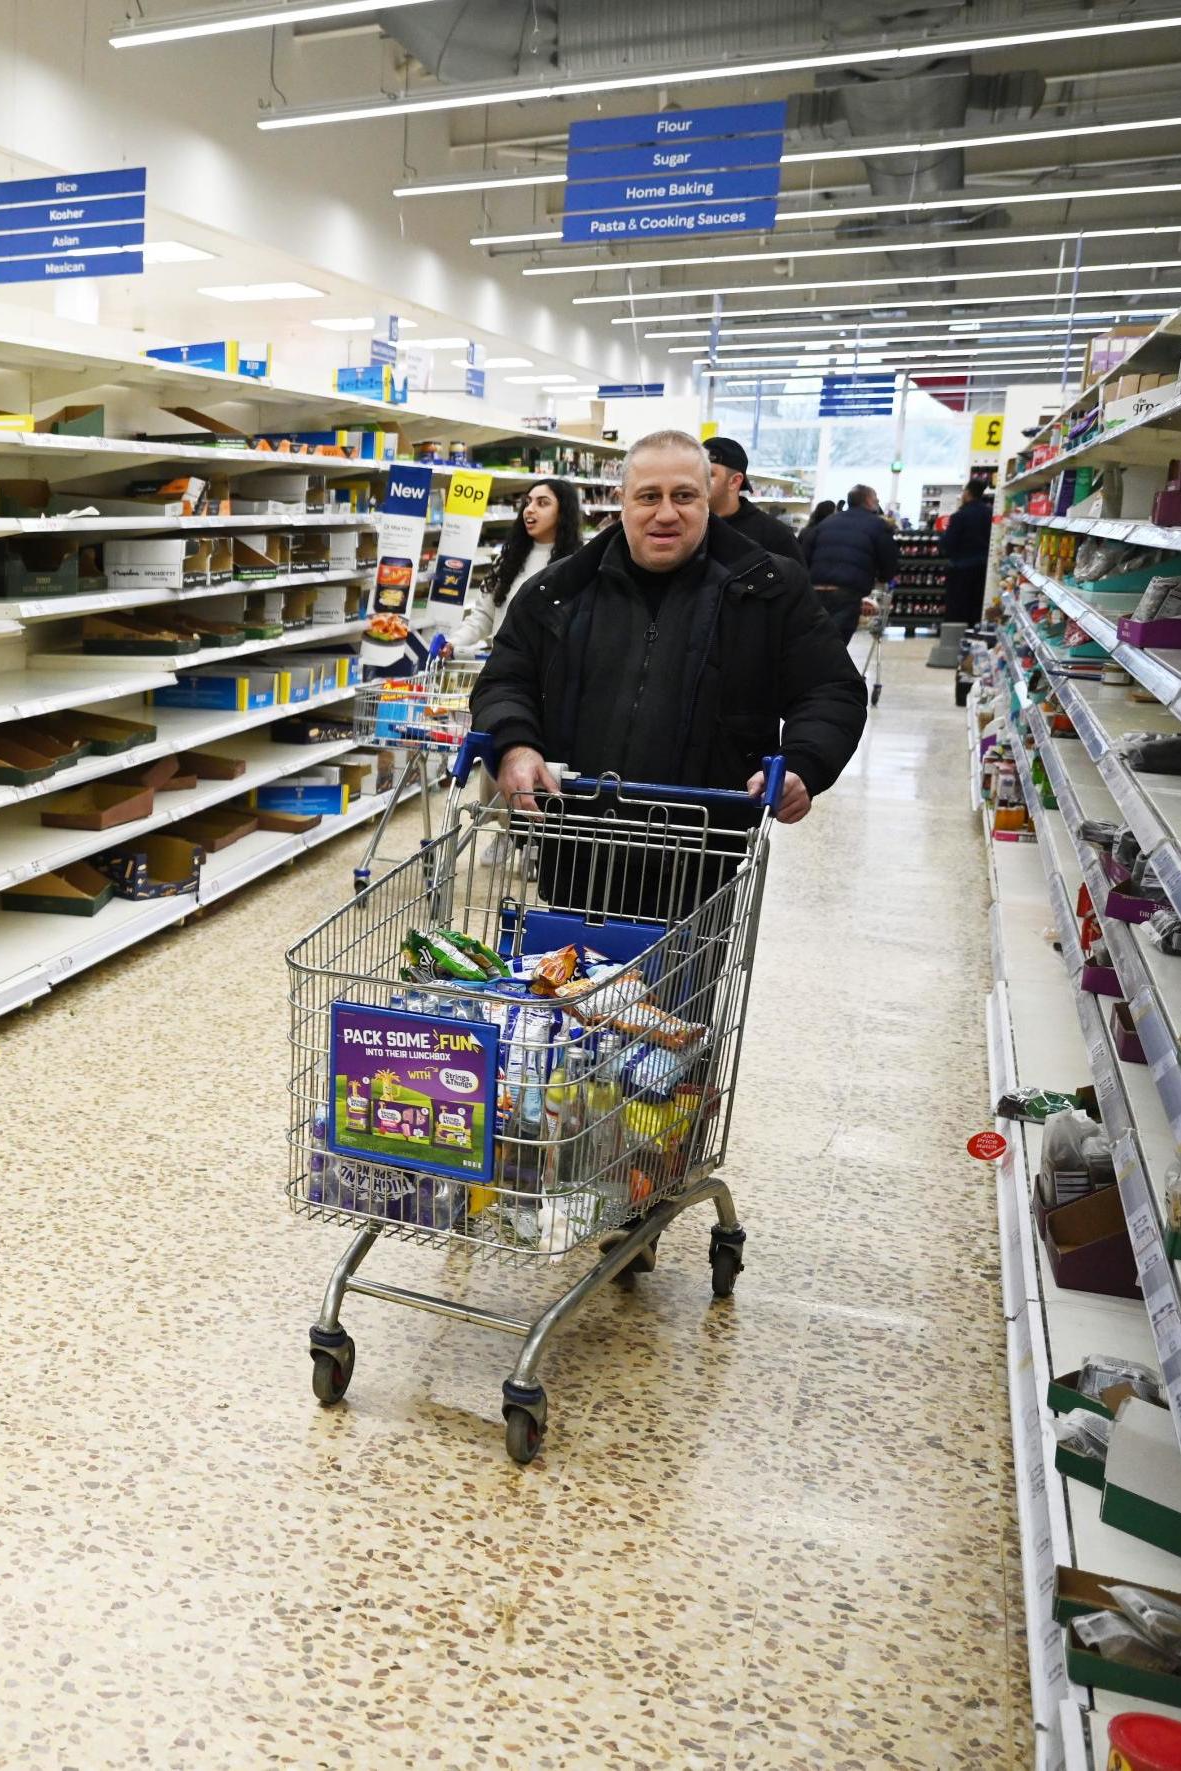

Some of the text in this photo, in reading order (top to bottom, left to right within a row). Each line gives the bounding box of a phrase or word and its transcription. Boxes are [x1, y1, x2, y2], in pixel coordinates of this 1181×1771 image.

[656, 120, 692, 133] Flour
[653, 153, 691, 167] Sugar
[55, 182, 78, 193] Rice
[626, 182, 713, 199] Home Baking
[49, 208, 84, 221] Kosher
[590, 211, 746, 233] Pasta & Cooking Sauces
[52, 236, 79, 247] Asian
[45, 262, 85, 274] Mexican
[986, 420, 1001, 447] £
[390, 482, 426, 499] New
[453, 484, 484, 503] 90p
[343, 1028, 472, 1051] PACK SOME FUN
[365, 1049, 451, 1061] INTO THEIR LUNCHBOX
[407, 1070, 432, 1080] WITH
[445, 1072, 470, 1083] Strings
[445, 1079, 473, 1088] &Things
[356, 1165, 392, 1179] SPRNG
[1048, 1663, 1063, 1686] £1
